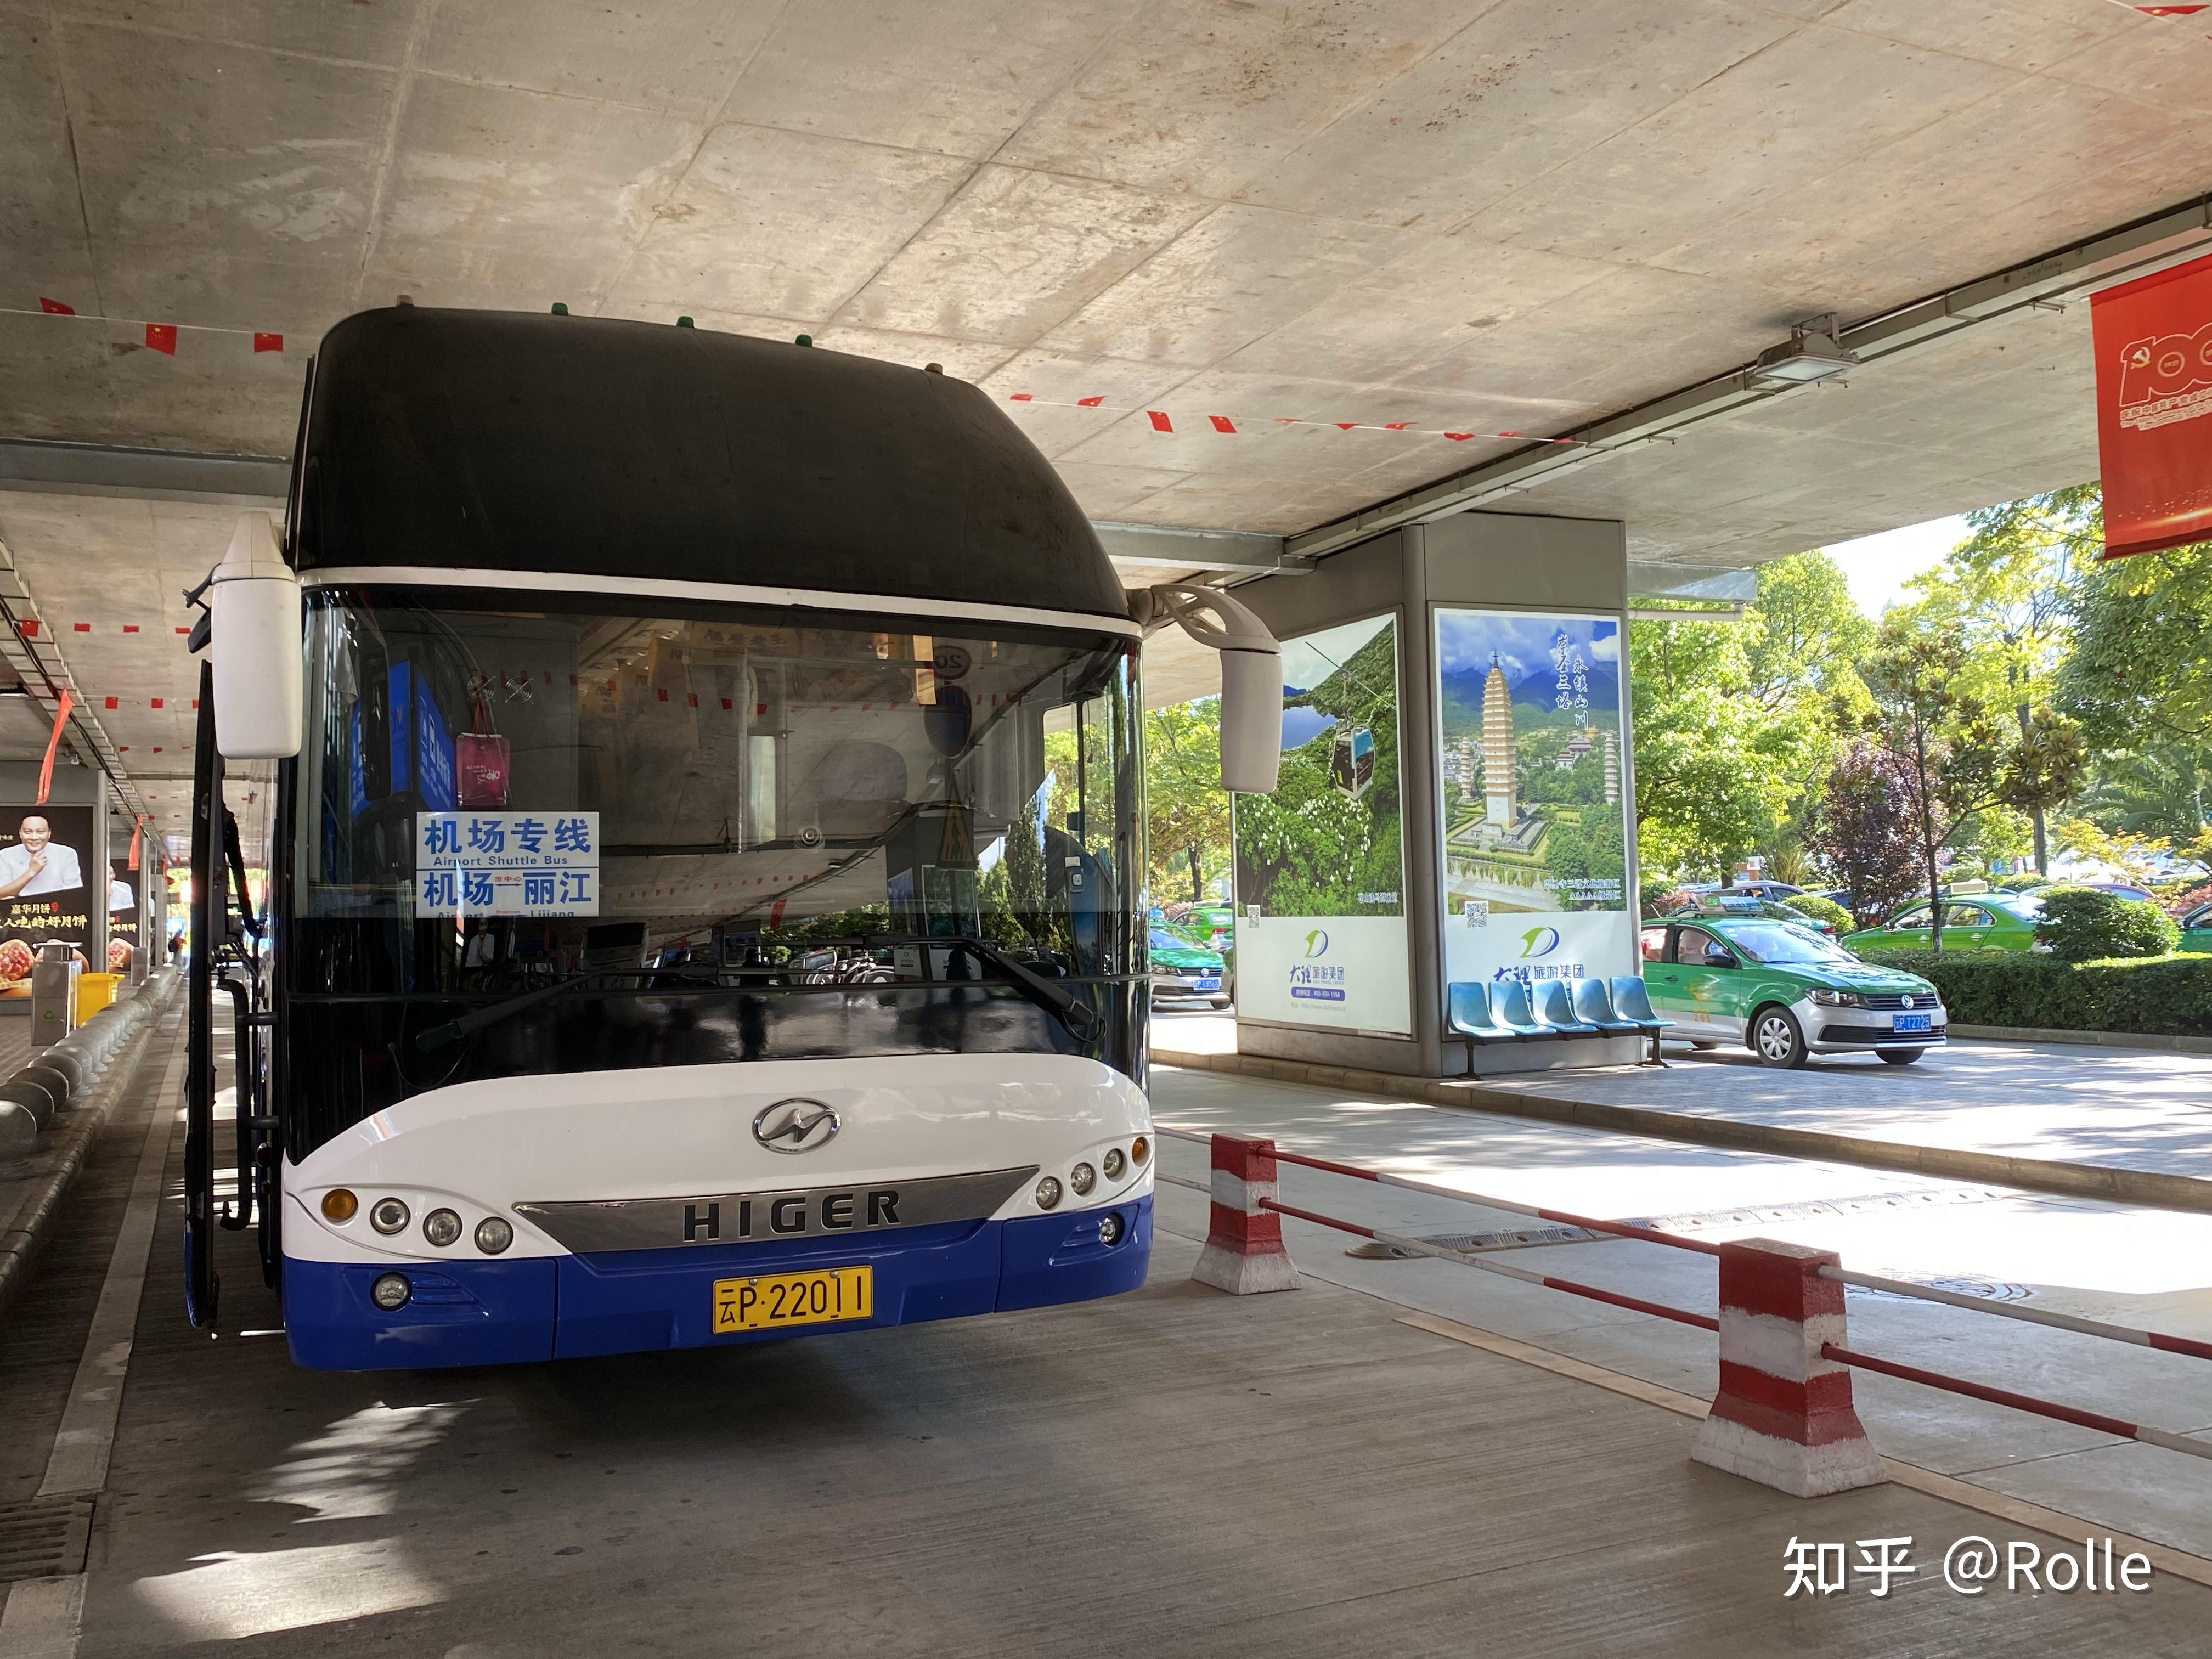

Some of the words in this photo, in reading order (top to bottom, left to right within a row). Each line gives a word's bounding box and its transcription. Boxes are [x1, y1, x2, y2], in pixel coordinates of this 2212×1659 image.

[1556, 634, 1572, 709] 崇圣三塔
[1573, 654, 1589, 731] 永镇山川
[424, 818, 591, 854] 机场专线
[433, 856, 481, 867] Airport
[488, 856, 537, 865] Shuttle
[544, 855, 568, 865] Bus
[424, 871, 494, 907] 机场
[523, 871, 591, 905] 丽江
[11, 904, 50, 915] 嘉华月饼
[683, 1190, 901, 1242] HIGER
